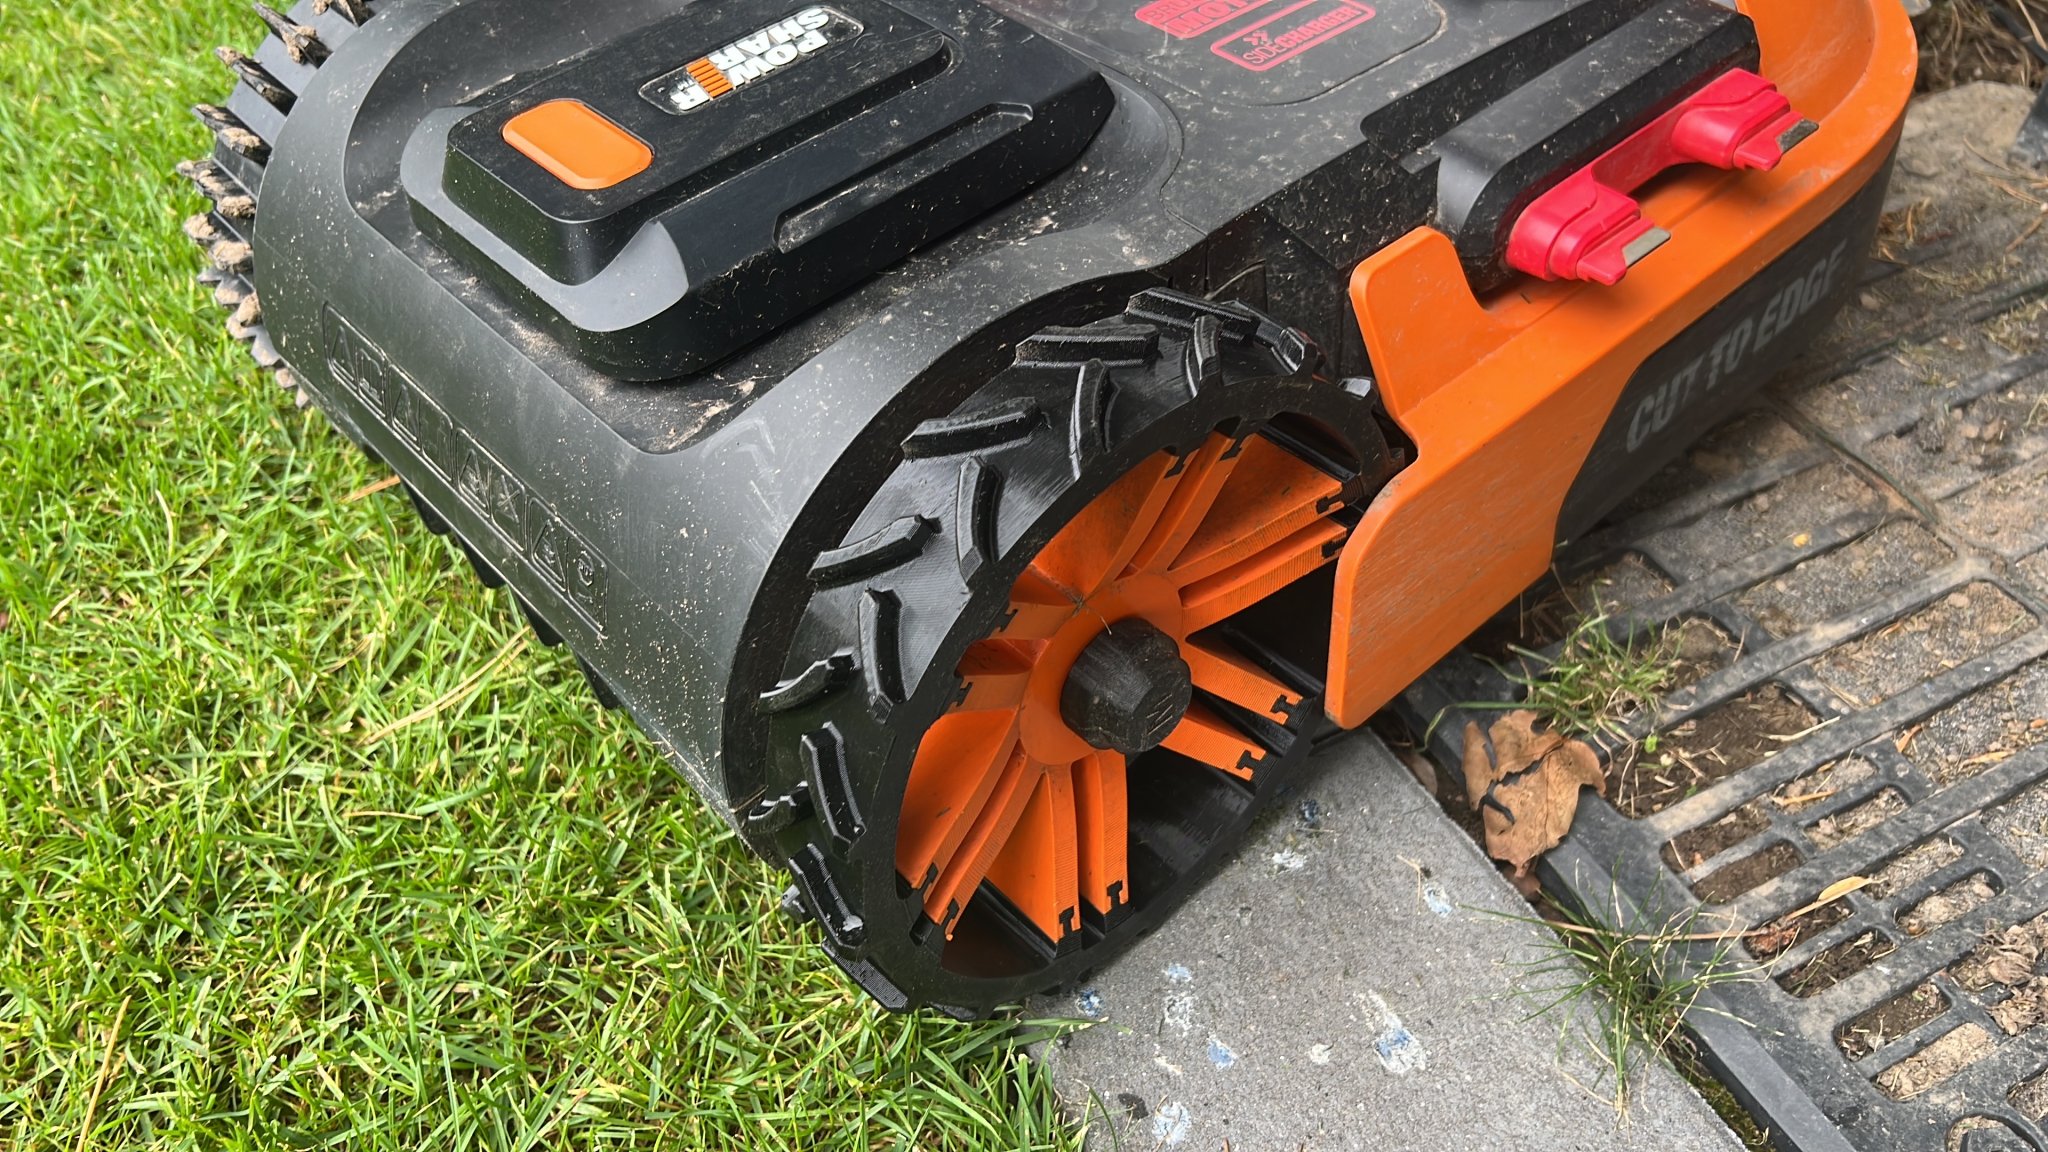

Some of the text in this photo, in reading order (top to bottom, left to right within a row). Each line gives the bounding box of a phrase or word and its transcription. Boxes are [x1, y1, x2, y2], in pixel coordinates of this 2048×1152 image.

[1142, 0, 1198, 20] BRU
[1626, 353, 1703, 454] CUT
[1705, 317, 1753, 390] TO
